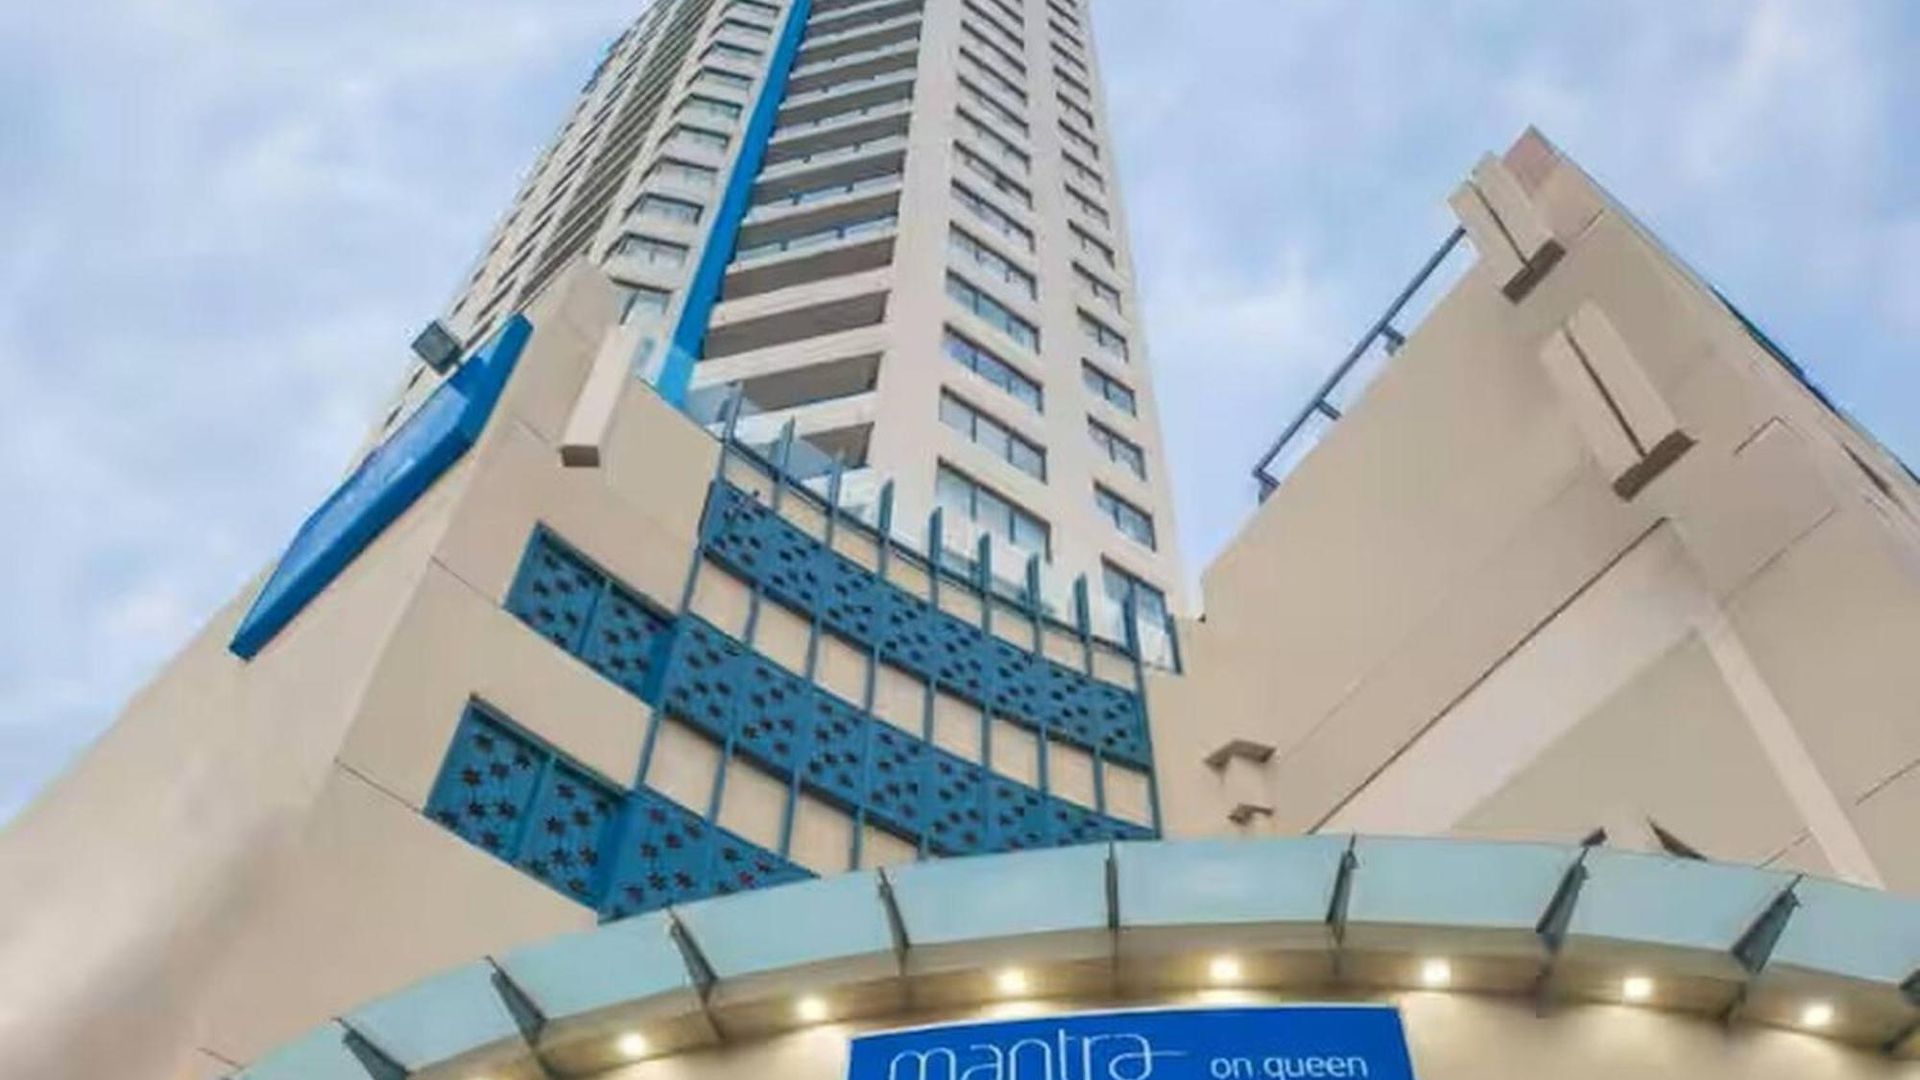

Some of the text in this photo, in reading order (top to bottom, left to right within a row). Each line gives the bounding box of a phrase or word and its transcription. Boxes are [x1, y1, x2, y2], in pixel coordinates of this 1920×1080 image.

[889, 1029, 1368, 1080] mantra on queen
